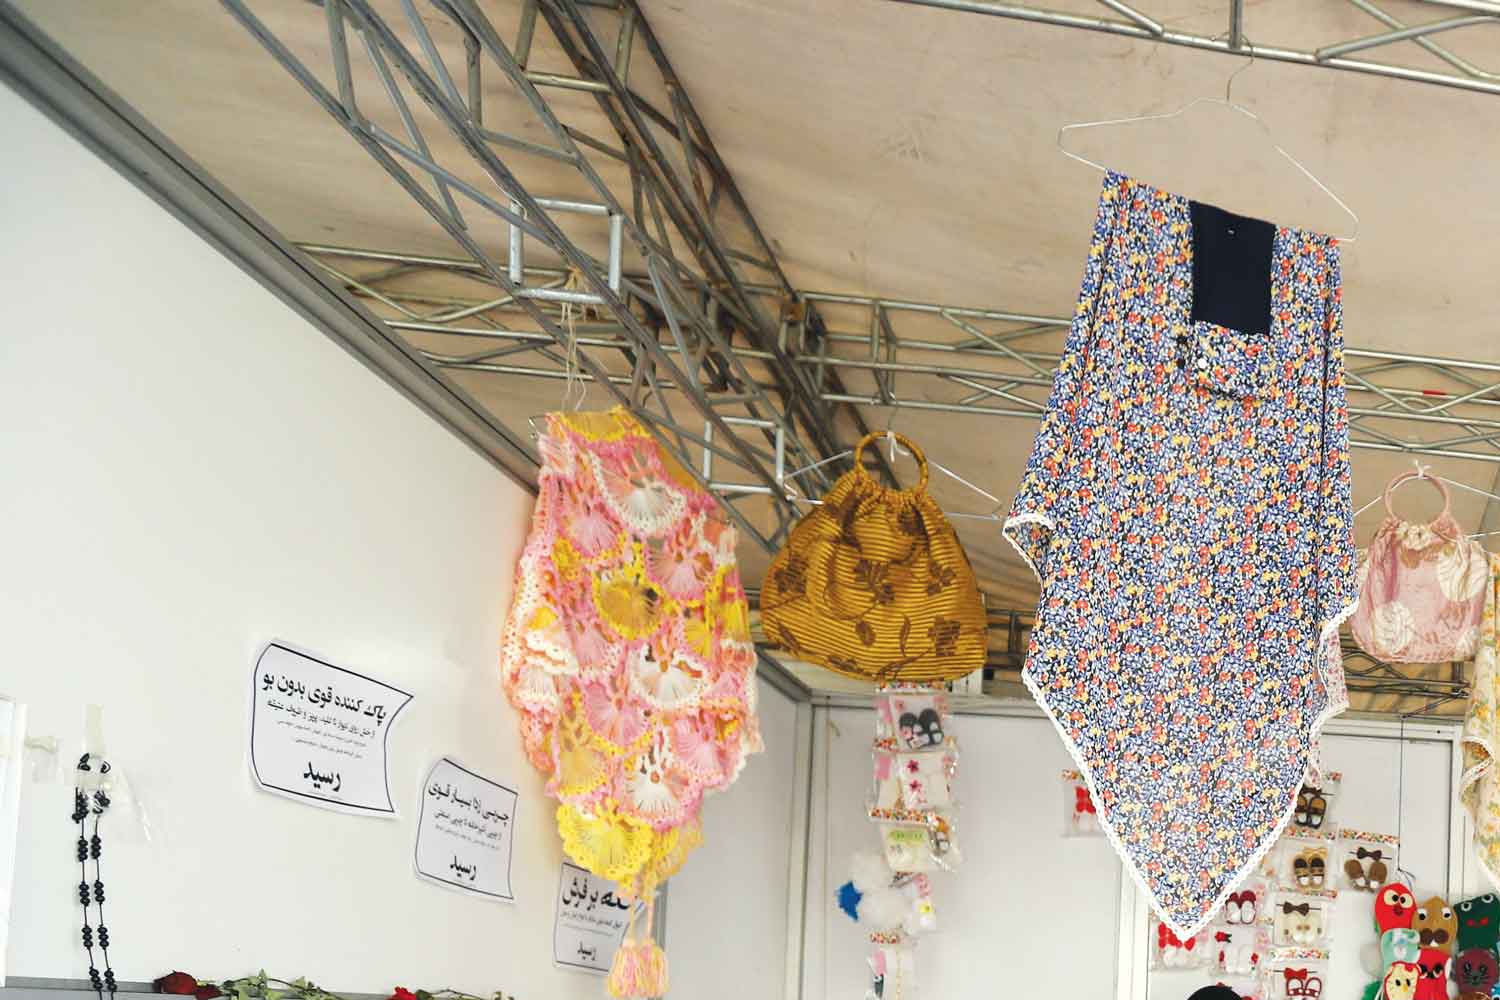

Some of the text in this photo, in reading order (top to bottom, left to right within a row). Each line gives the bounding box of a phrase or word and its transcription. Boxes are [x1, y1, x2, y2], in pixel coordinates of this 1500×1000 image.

[262, 673, 387, 727] پاک کننده قوی بدون بو
[303, 761, 341, 792] رسید
[428, 783, 450, 800] قوی
[450, 855, 477, 881] رسید
[562, 877, 588, 908] فرش
[577, 940, 597, 961] رسید
